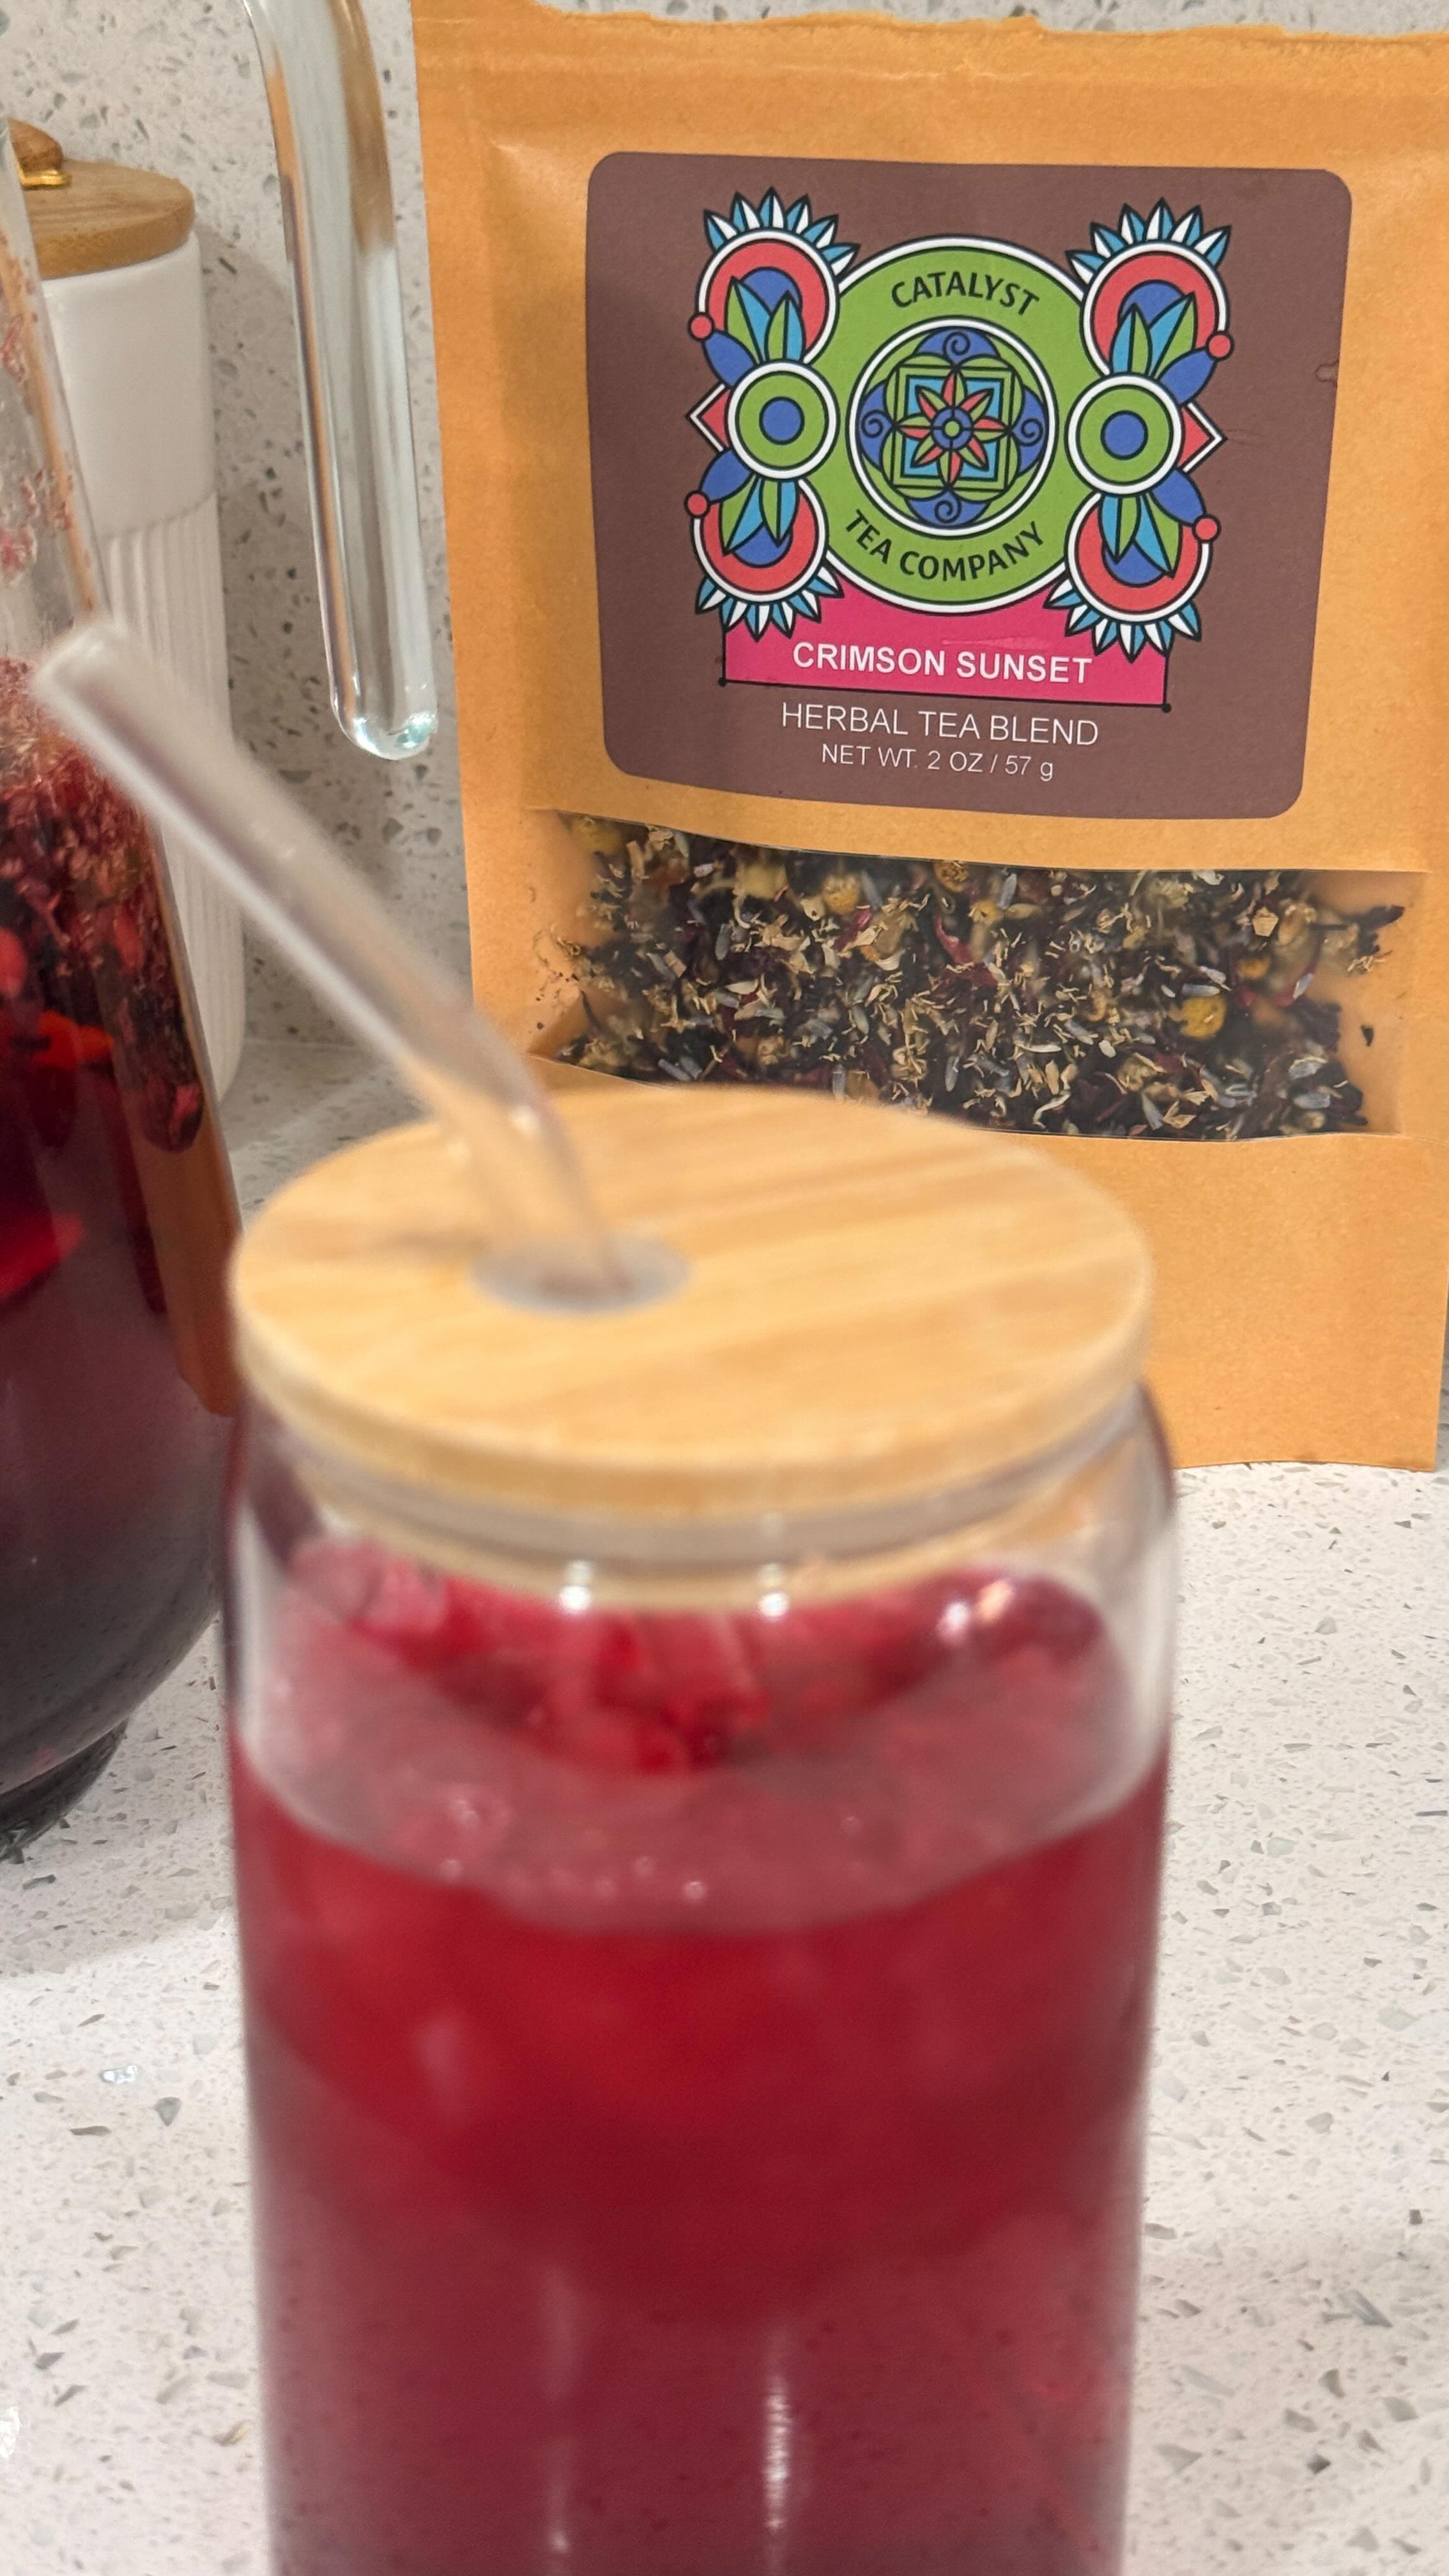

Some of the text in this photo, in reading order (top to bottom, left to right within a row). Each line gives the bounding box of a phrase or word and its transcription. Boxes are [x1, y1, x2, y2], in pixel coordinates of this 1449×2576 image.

[892, 271, 1039, 316] CATALYST
[845, 509, 1043, 581] TEA COMPANY
[793, 642, 1092, 684] CRIMSON SUNSET
[782, 702, 1098, 745] HERBAL TEA BLEND
[822, 743, 1054, 782] NET WT. 2 OZ / 57 g
